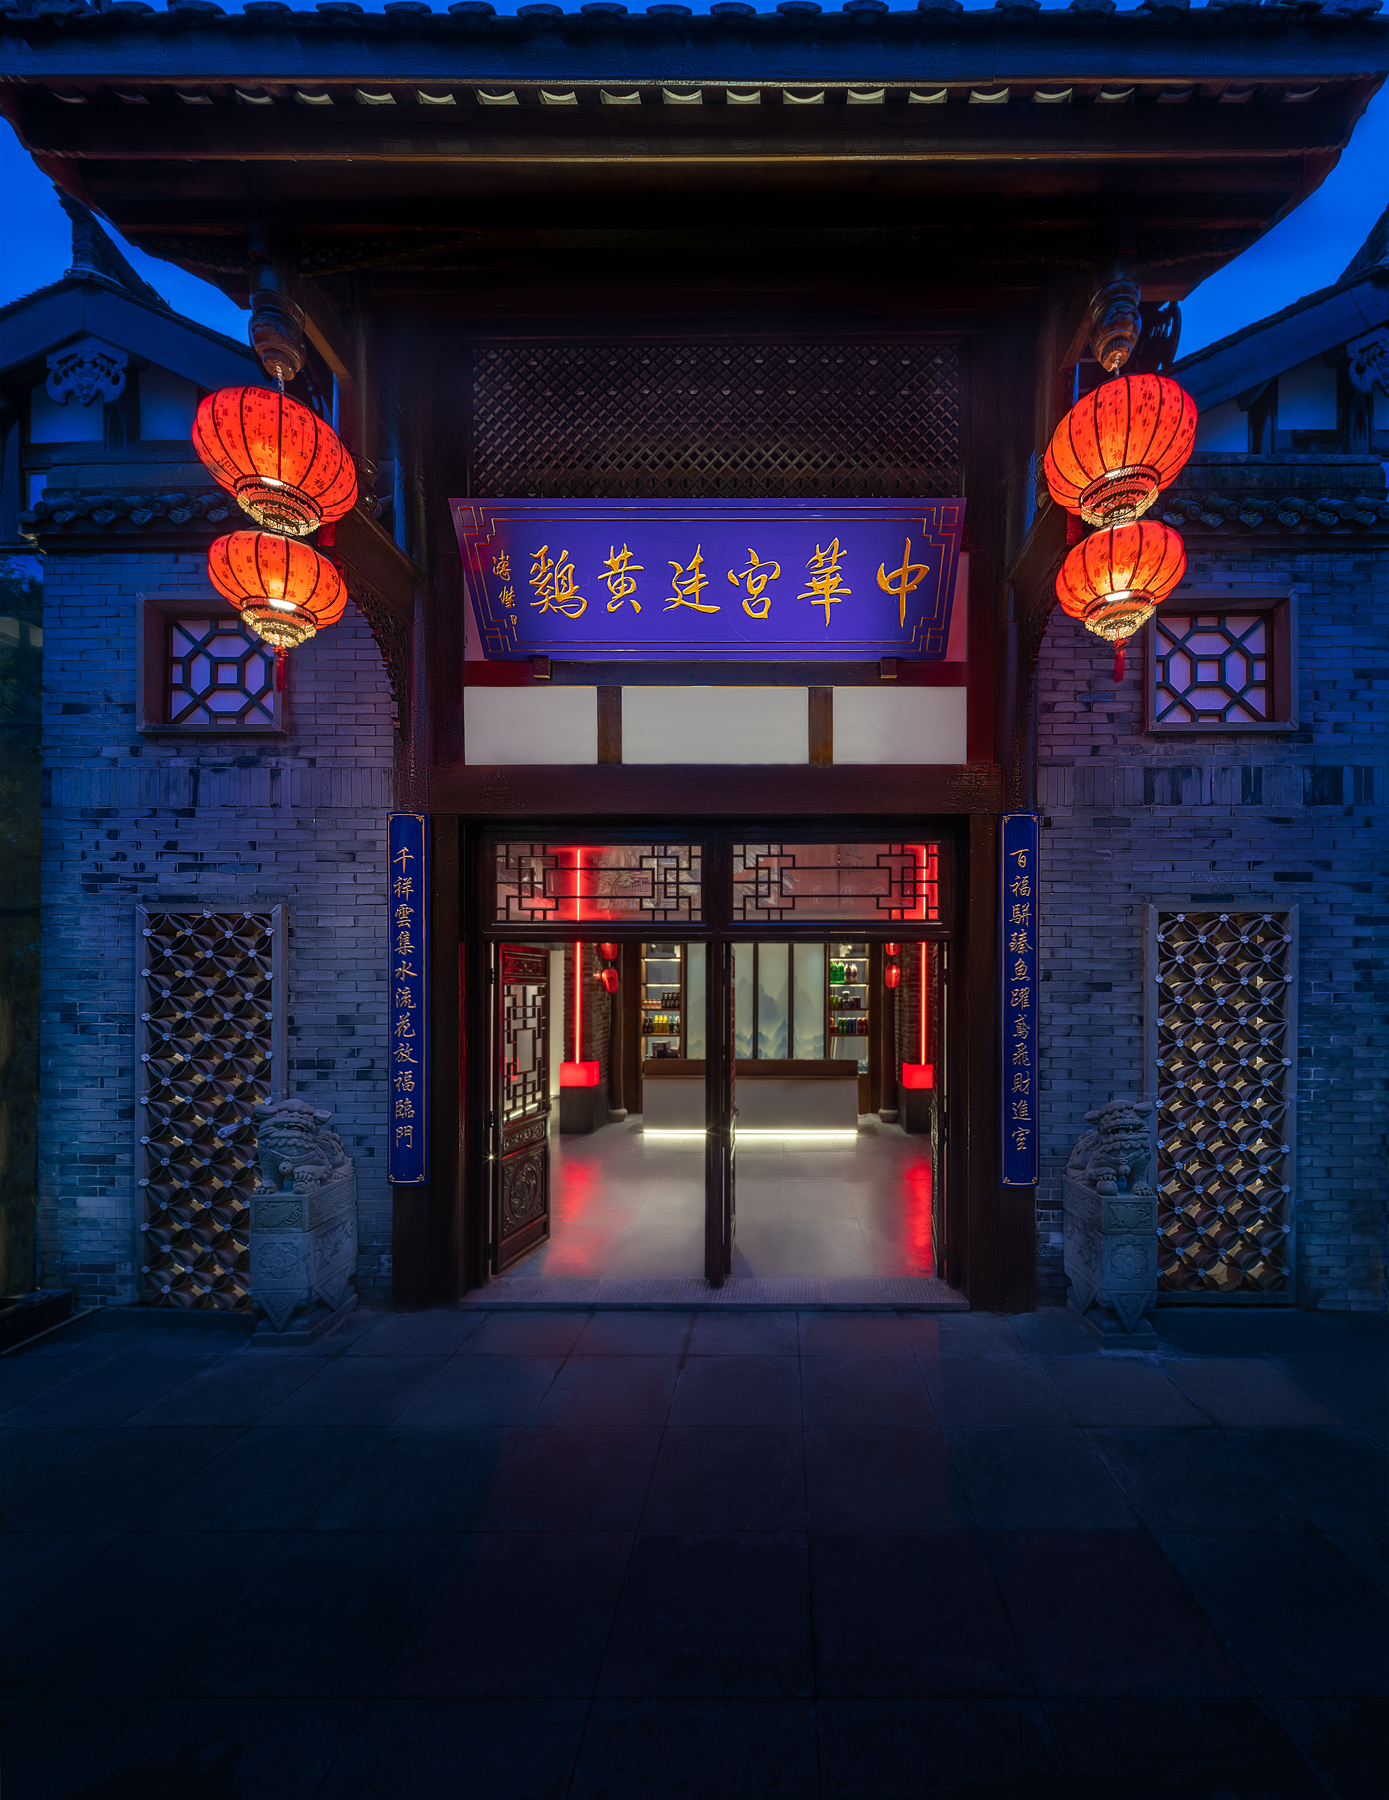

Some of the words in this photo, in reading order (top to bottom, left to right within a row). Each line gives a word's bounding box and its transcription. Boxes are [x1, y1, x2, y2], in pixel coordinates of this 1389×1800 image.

[393, 847, 418, 1149] 千祥雲集水流花放福臨門
